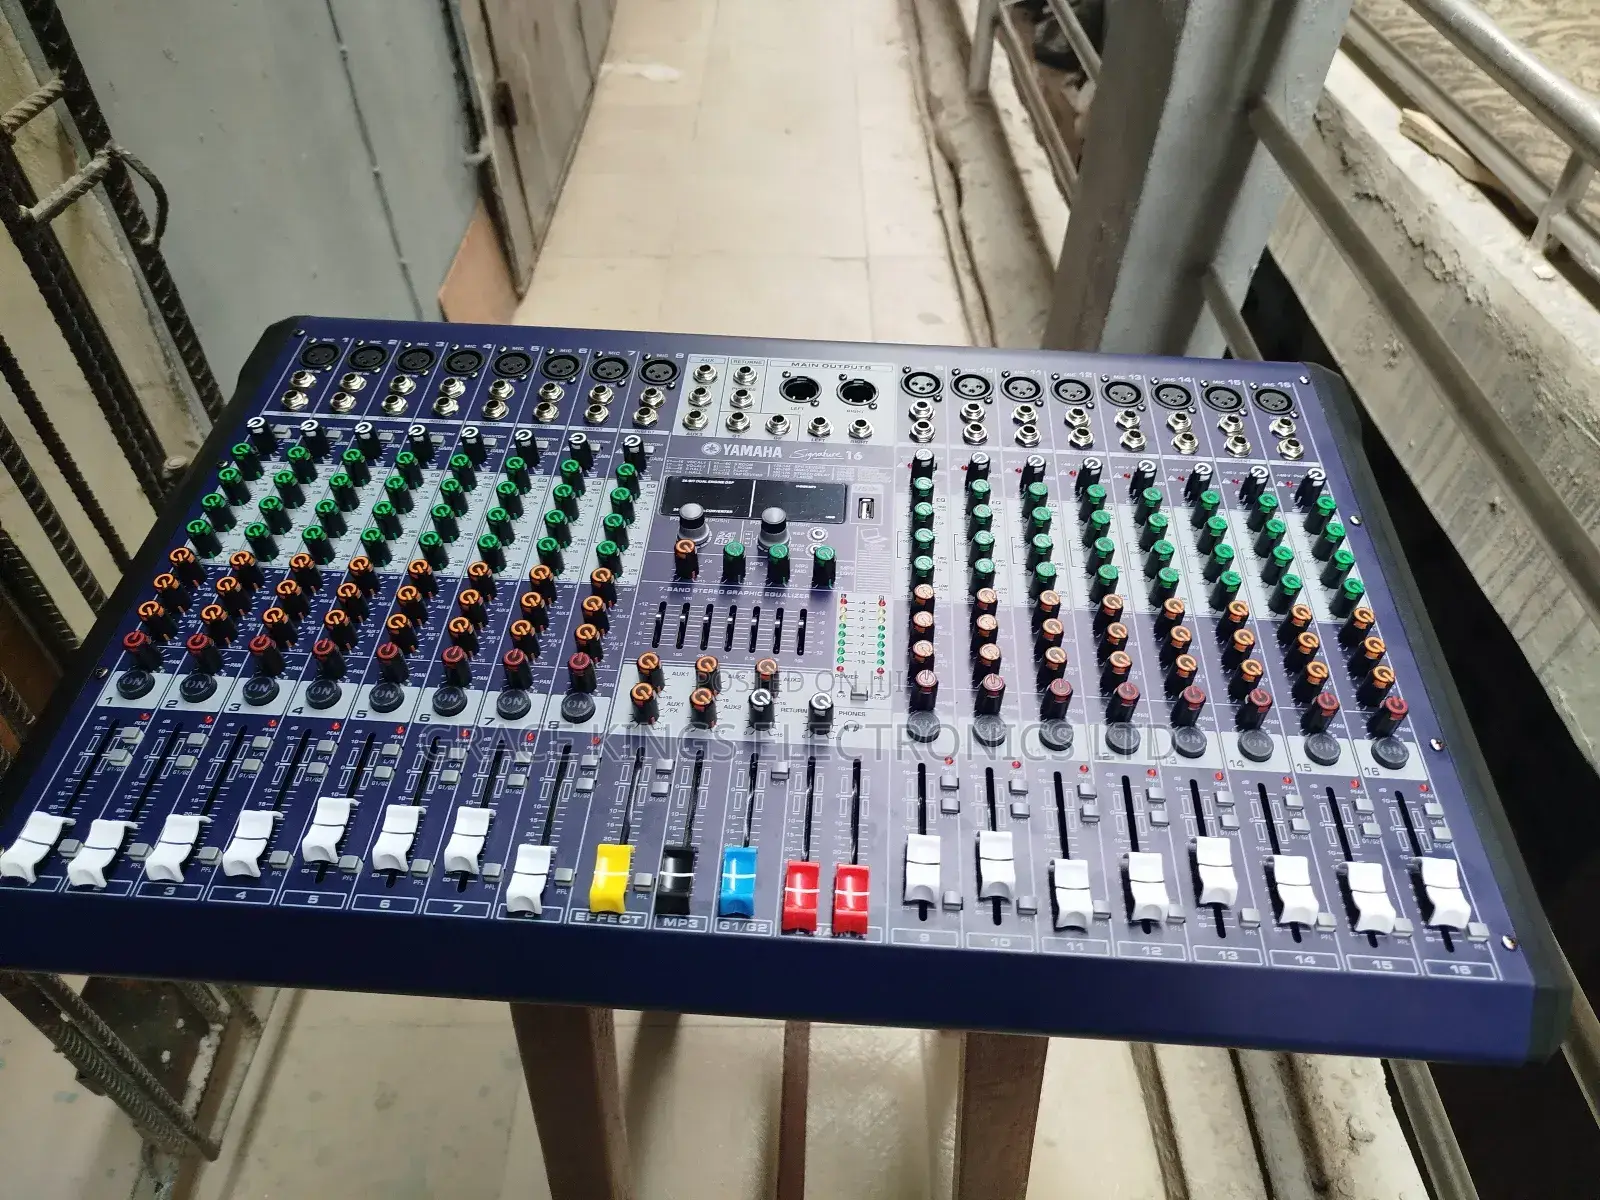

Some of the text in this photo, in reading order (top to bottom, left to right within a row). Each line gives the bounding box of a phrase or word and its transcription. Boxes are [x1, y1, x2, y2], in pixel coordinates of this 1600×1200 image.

[723, 444, 863, 461] YAMAHA Signature 16
[122, 678, 142, 687] ON
[185, 681, 206, 690] ON
[249, 683, 269, 693] ON
[312, 687, 332, 696] ON
[376, 690, 395, 700] ON
[438, 693, 458, 702] ON
[165, 699, 179, 708] 2
[503, 696, 523, 706] ON
[567, 700, 587, 709] ON
[228, 703, 242, 712] 3
[292, 706, 304, 715] 4
[355, 710, 368, 718] 5
[419, 713, 432, 722] 6
[483, 717, 495, 726] 7
[548, 721, 560, 729] 8
[1230, 759, 1244, 768] 14
[1297, 763, 1312, 772] 15
[1364, 766, 1380, 776] 16
[163, 886, 176, 895] 3
[235, 890, 247, 900] 4
[308, 896, 319, 904] 5
[379, 900, 391, 909] 6
[453, 904, 464, 913] 7
[575, 912, 642, 925] EFFECT
[663, 918, 699, 928] MP3
[719, 921, 769, 933] G1/G2
[919, 933, 931, 943] 9
[990, 937, 1011, 947] 10
[1067, 942, 1085, 951] 11
[1141, 946, 1162, 956] 12
[1217, 950, 1239, 961] 13
[1295, 954, 1316, 965] 14
[1372, 960, 1394, 970] 15
[1449, 964, 1471, 976] 16
